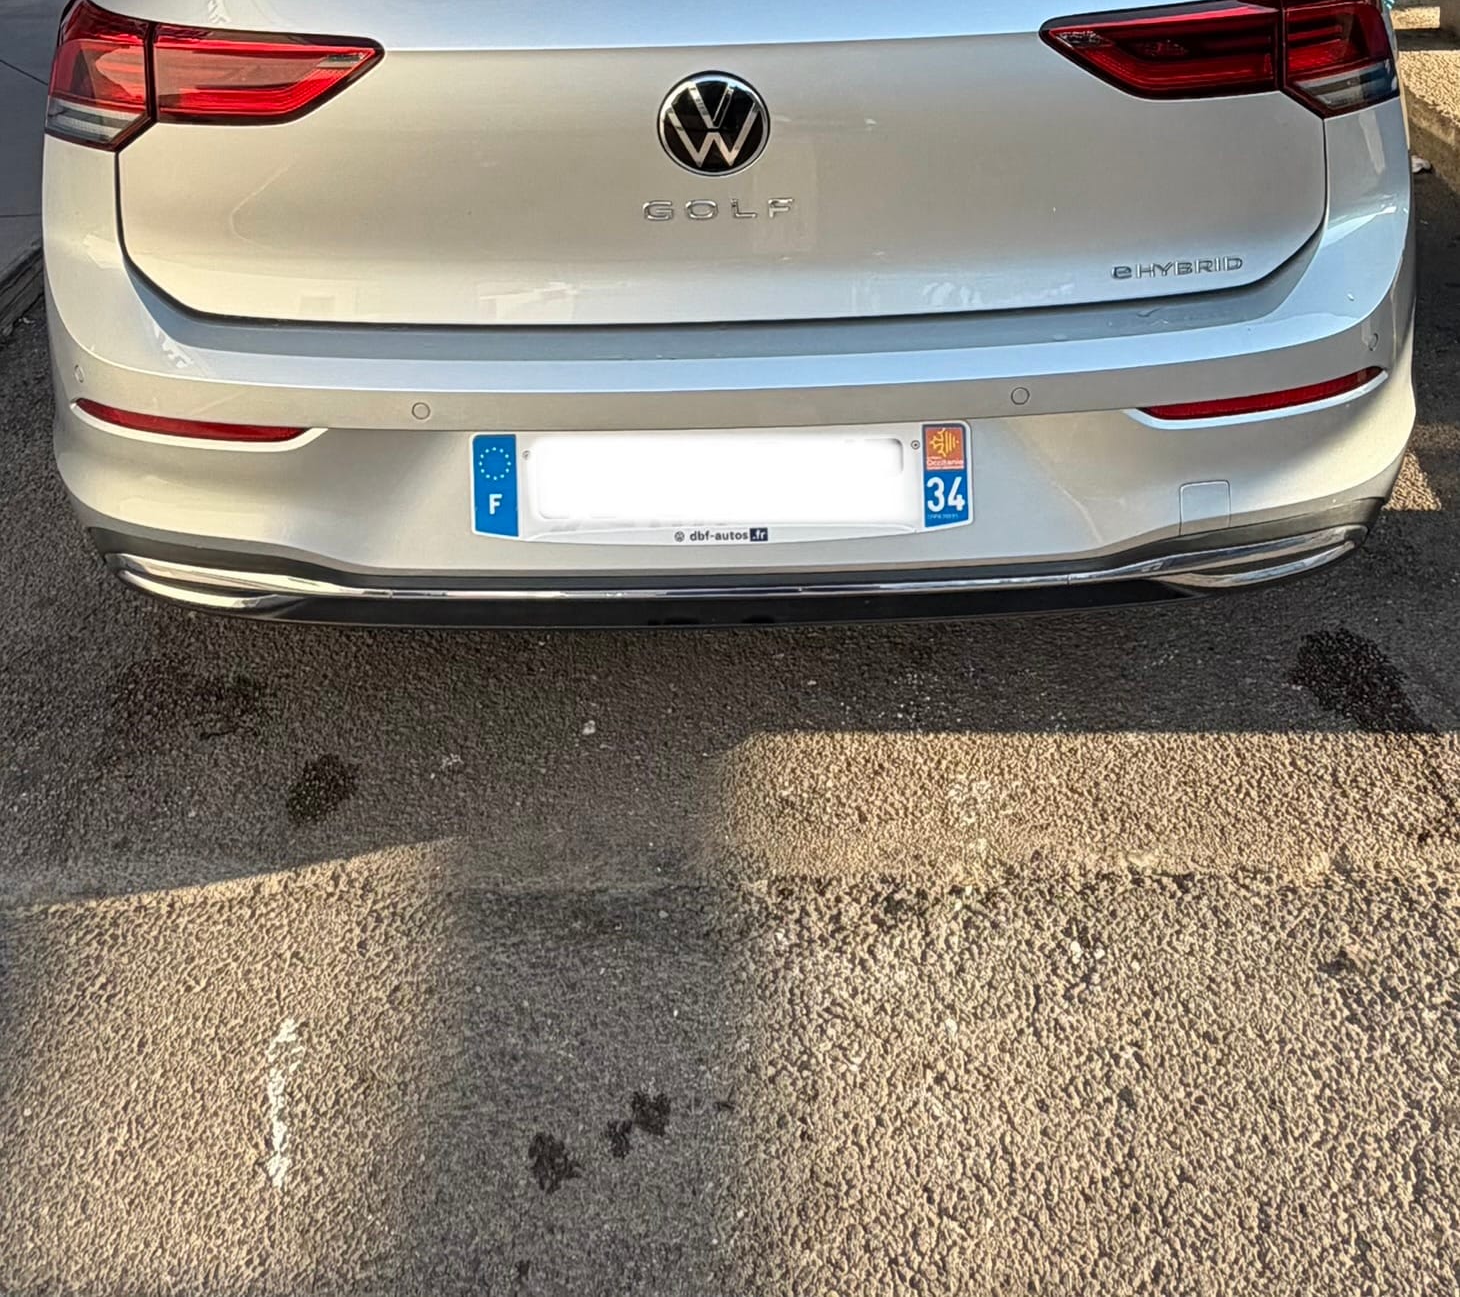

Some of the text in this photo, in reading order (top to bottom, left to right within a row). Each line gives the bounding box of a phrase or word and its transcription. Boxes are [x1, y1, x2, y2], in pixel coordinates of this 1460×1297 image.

[642, 198, 795, 221] GOLF
[488, 493, 503, 515] F
[926, 476, 966, 513] 34
